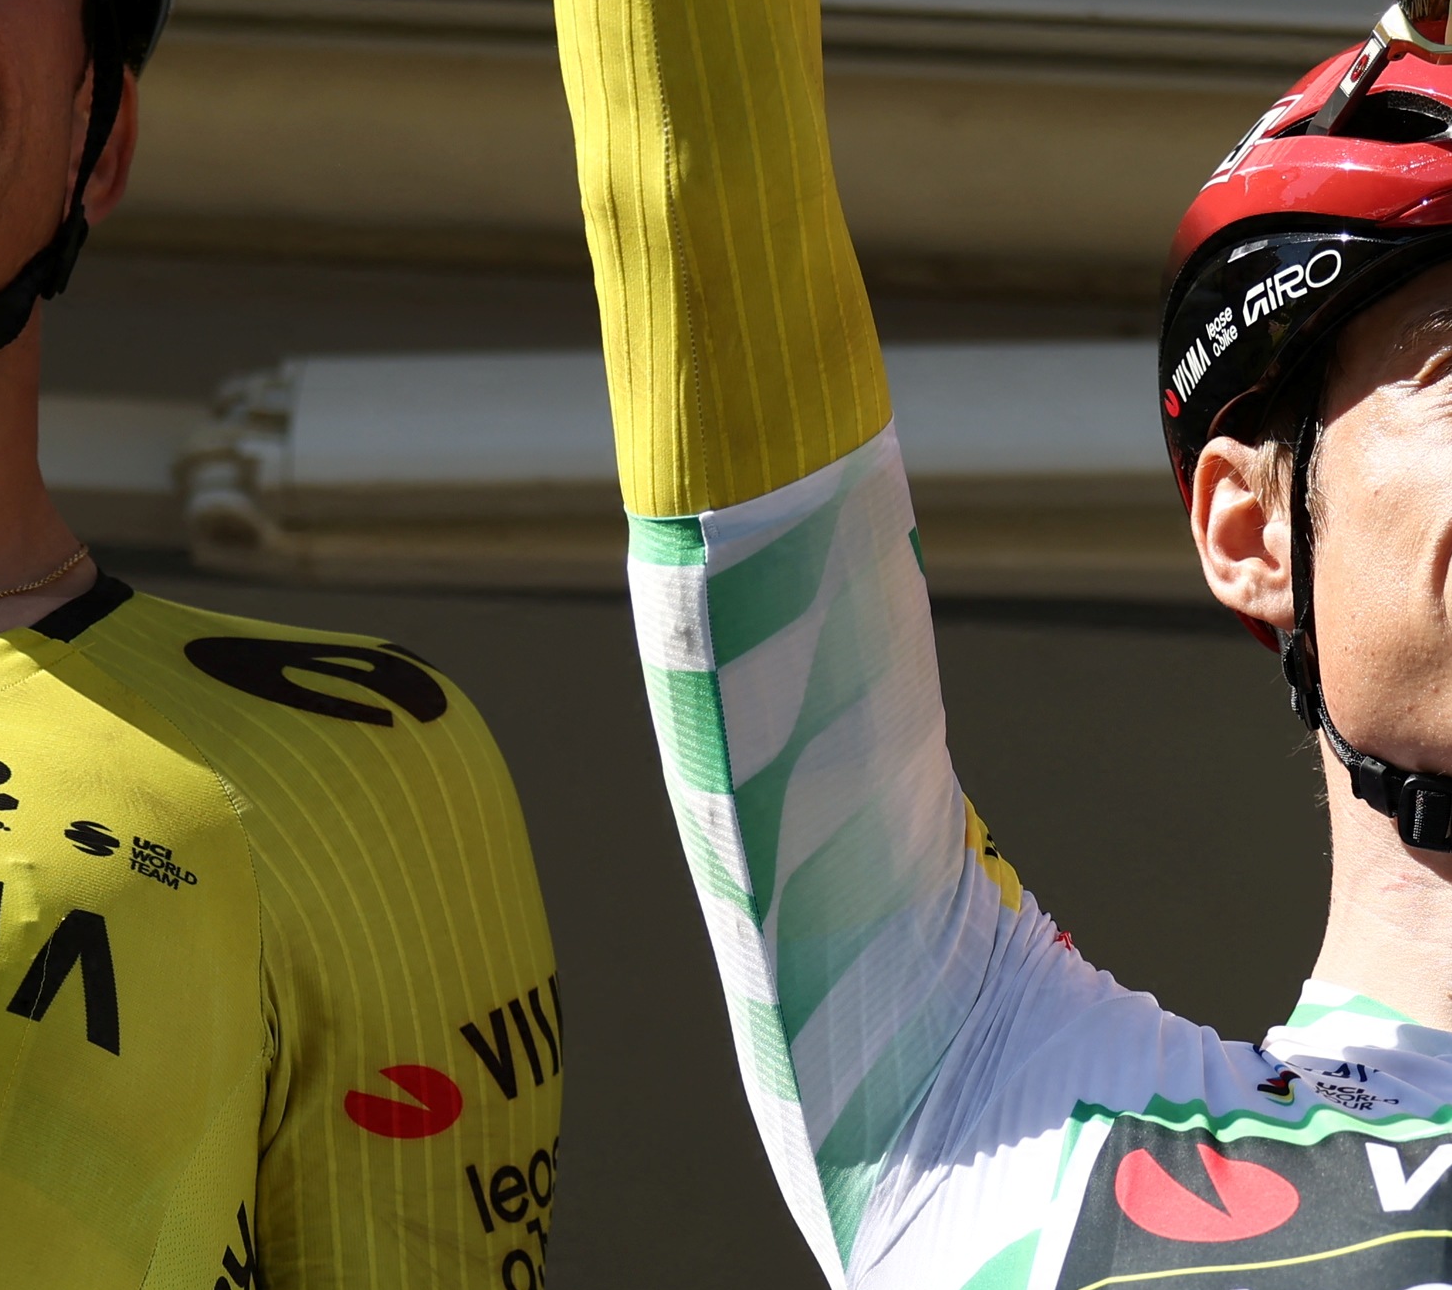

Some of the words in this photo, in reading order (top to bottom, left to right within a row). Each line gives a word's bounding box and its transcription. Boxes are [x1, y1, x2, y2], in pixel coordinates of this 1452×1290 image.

[1242, 249, 1342, 328] GIRO
[1171, 337, 1211, 403] VISMA
[130, 846, 198, 887] WORLD
[133, 835, 172, 861] UCI
[129, 858, 179, 891] TEAM
[1316, 1082, 1366, 1094] UCI
